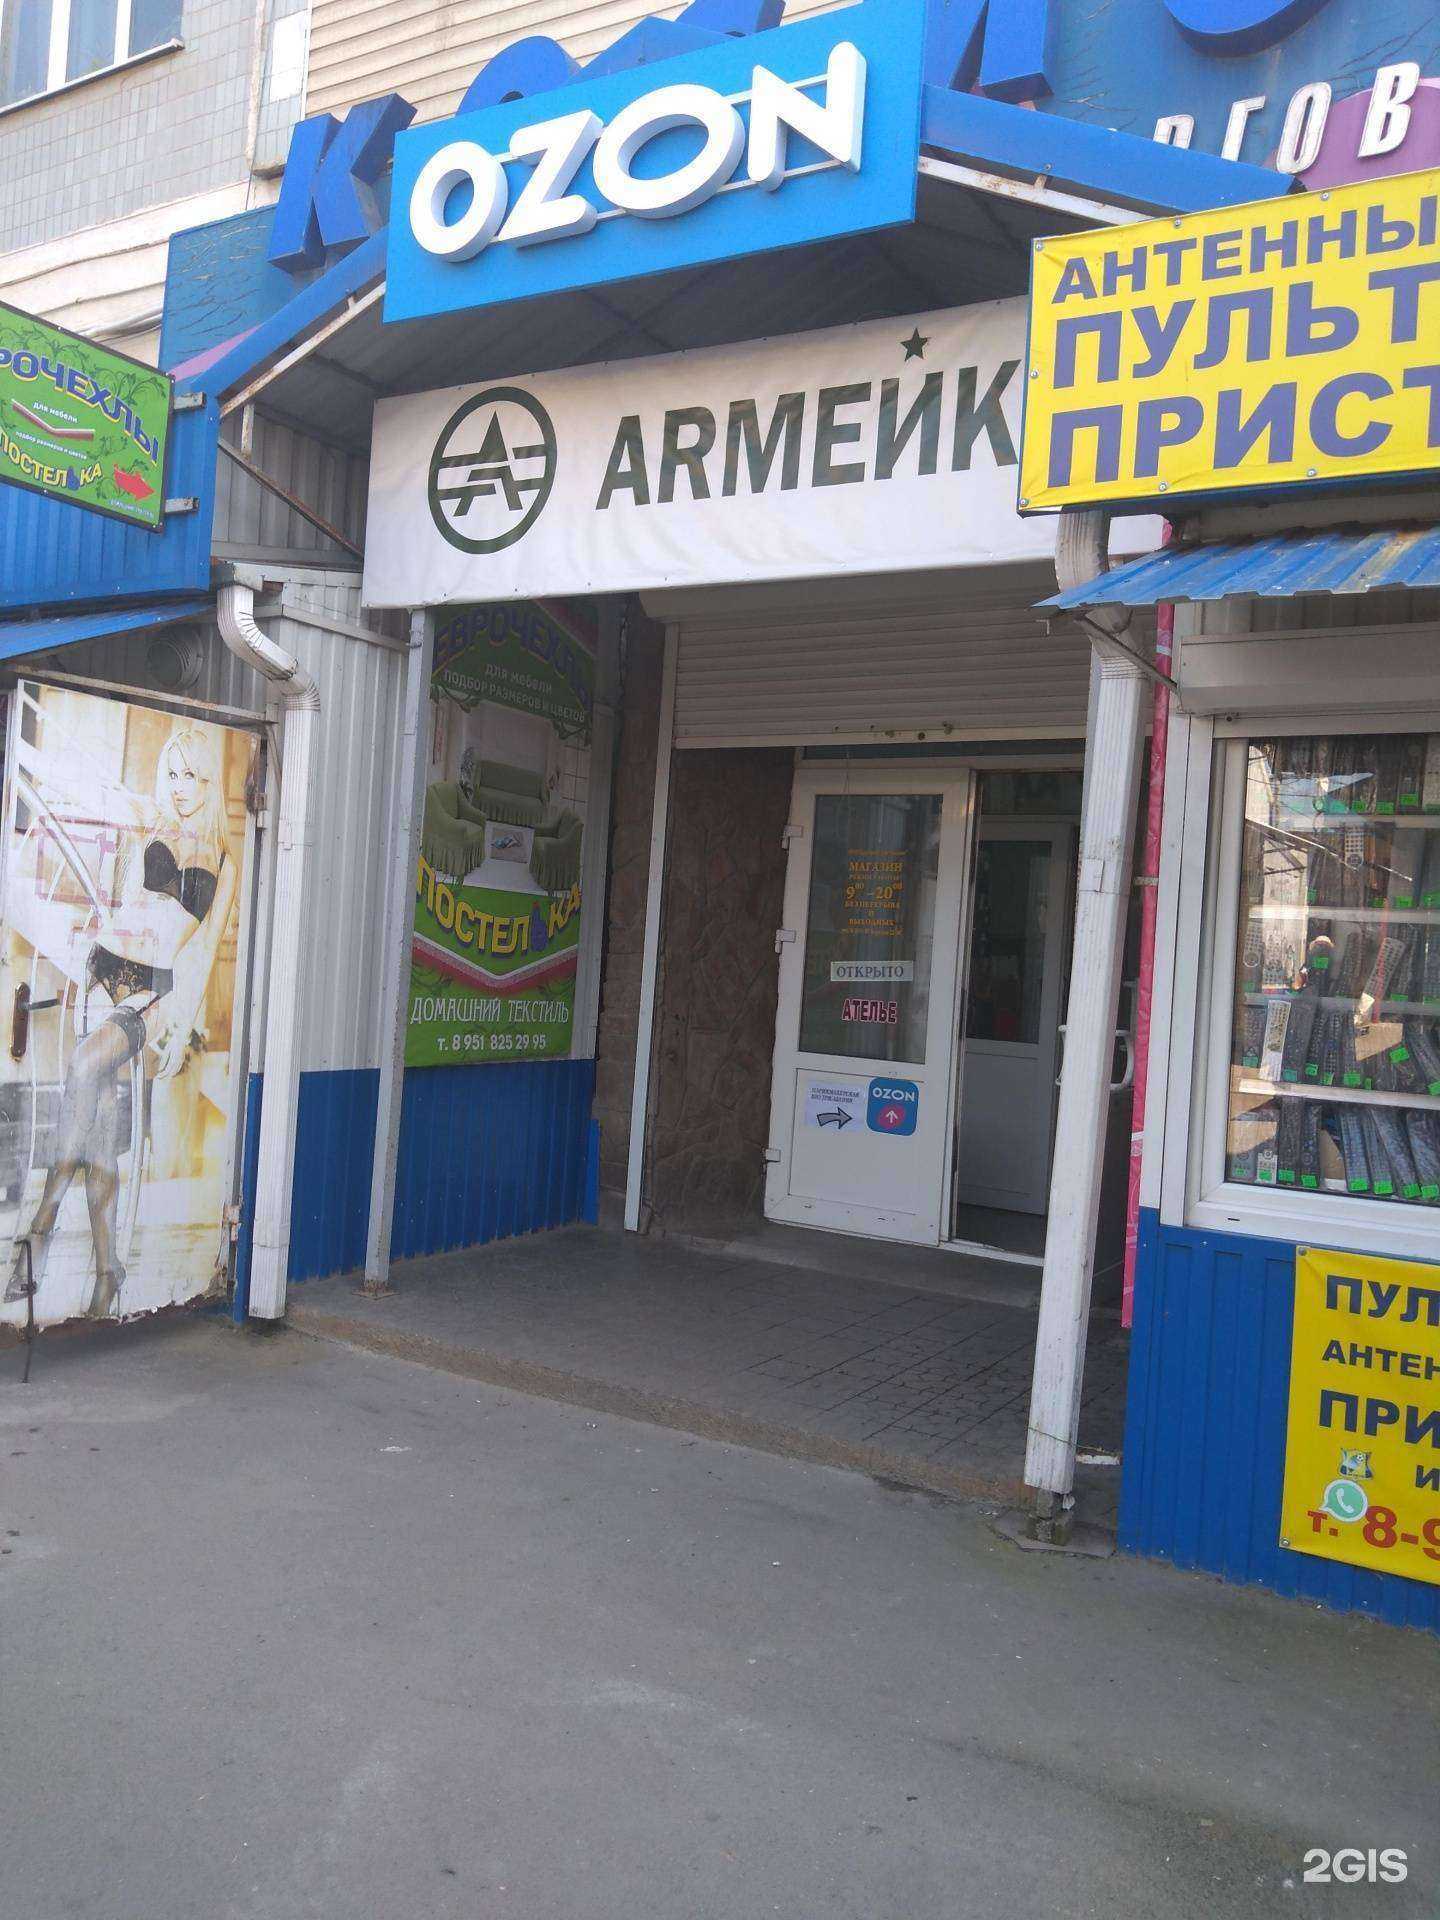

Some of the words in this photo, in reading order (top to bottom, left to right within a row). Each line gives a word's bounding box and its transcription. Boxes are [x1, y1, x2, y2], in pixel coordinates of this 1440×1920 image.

[409, 41, 867, 262] OZON
[1051, 196, 1438, 304] АНТЕННЫ
[1049, 263, 1440, 389] ПУЛЬТ
[836, 966, 904, 978] ОТКРЫТО
[410, 997, 500, 1024] ДОМАШНИЙ
[508, 999, 569, 1023] ТЕКСТИЛЬ
[842, 998, 897, 1023] АТЕЛЬЕ
[452, 1035, 461, 1049] 8
[464, 1034, 485, 1050] 951
[490, 1035, 513, 1050] 825
[516, 1035, 530, 1049] 29
[532, 1034, 546, 1049] 95
[872, 1087, 915, 1102] OZON
[1326, 1274, 1440, 1327] ПУЛ
[1319, 1389, 1440, 1450] ПРИ
